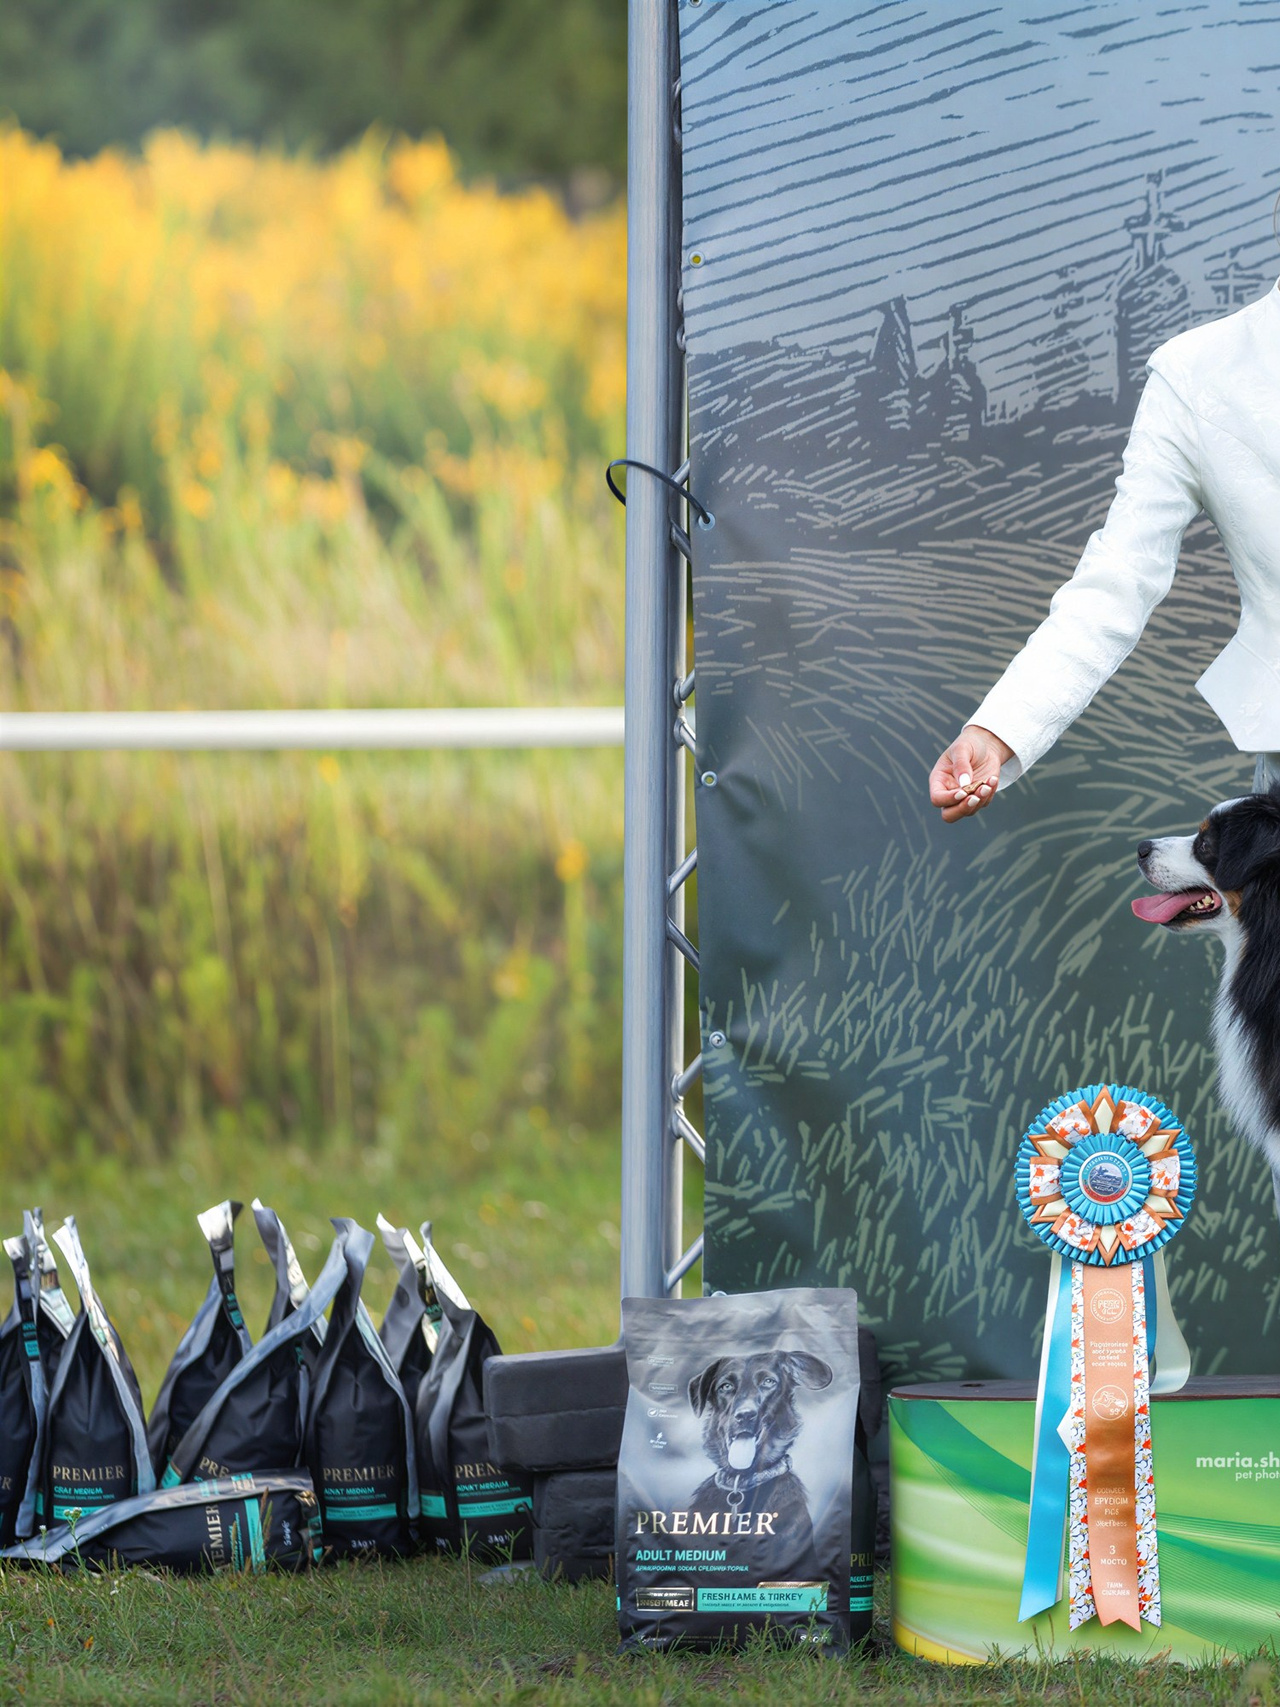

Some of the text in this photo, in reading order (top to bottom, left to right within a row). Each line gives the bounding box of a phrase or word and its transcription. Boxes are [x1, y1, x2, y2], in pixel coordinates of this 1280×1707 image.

[52, 1464, 126, 1482] PREMIER
[322, 1465, 397, 1484] PREMIER
[634, 1510, 776, 1536] PREMIER
[635, 1549, 727, 1562] ADULT MEDIUM
[701, 1592, 731, 1601] FRESH
[759, 1592, 766, 1601] &
